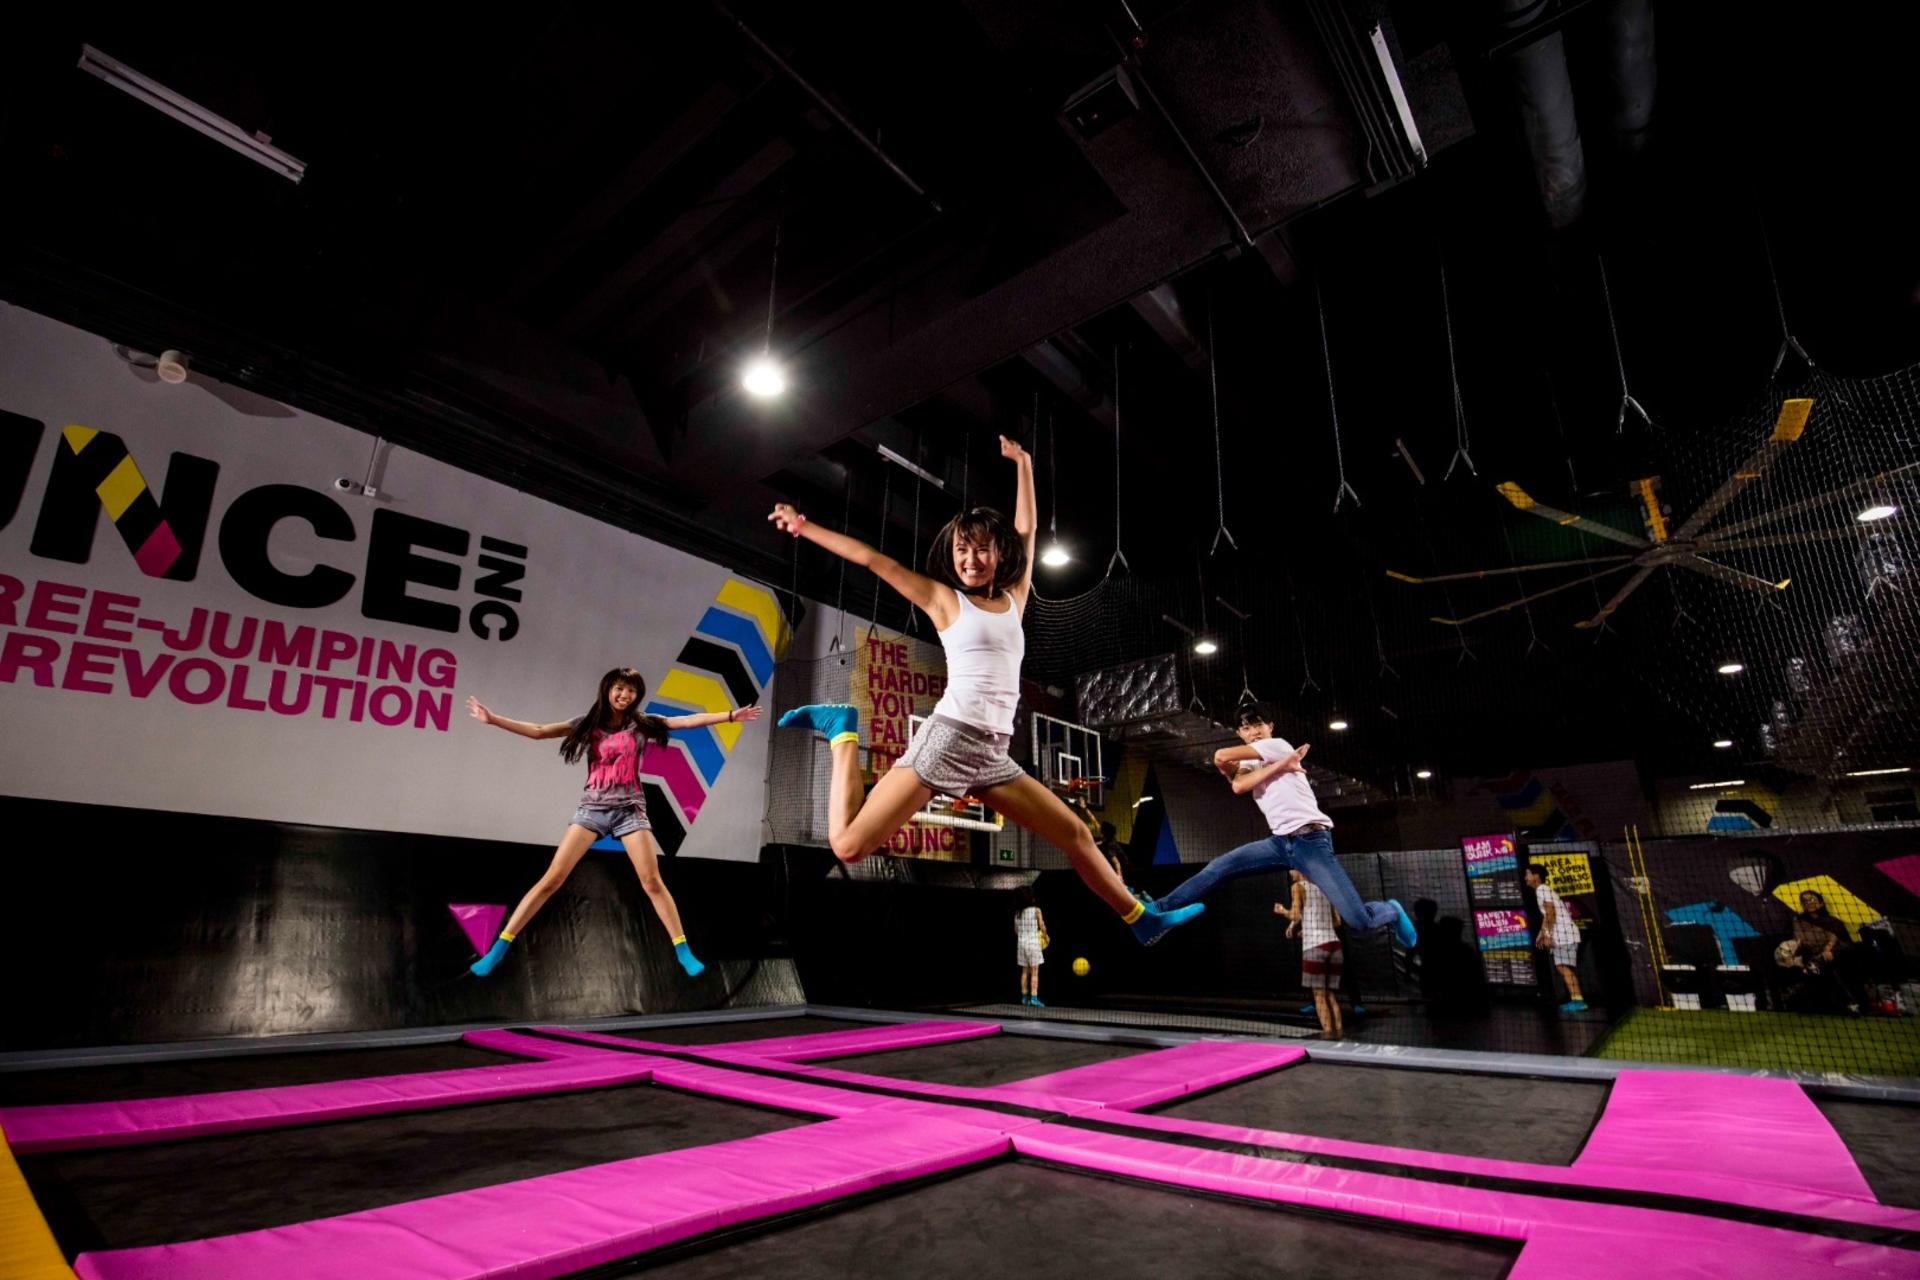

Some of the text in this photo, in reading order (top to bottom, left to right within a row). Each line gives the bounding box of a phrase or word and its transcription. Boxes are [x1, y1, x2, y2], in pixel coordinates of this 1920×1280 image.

[0, 408, 471, 634] NCE
[469, 535, 529, 642] INC
[867, 638, 908, 669] THE
[0, 632, 453, 732] REVOLUTION
[868, 690, 914, 719] YOU
[870, 718, 917, 745] FAL
[882, 826, 966, 854] OUNCE
[1553, 872, 1590, 884] PUBLIC
[1559, 863, 1586, 874] OPEN
